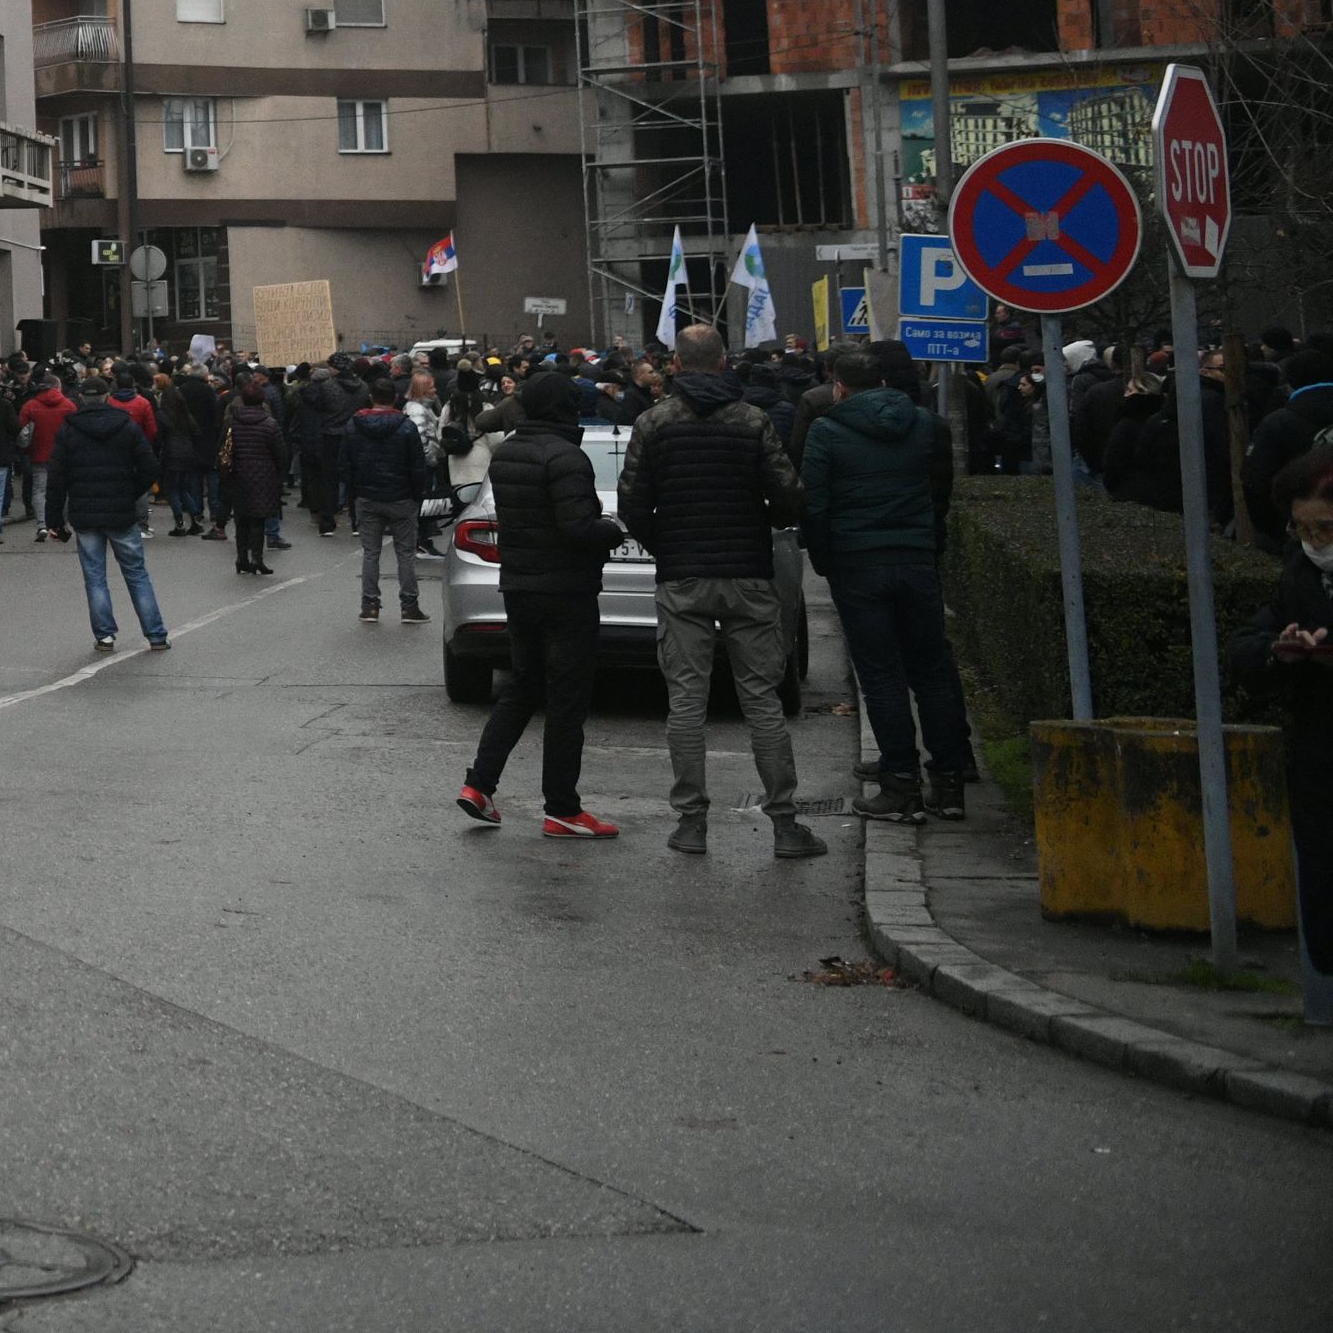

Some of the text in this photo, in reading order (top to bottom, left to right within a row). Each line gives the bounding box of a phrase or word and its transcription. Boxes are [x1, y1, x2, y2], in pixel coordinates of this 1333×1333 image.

[1170, 139, 1219, 204] STOP
[920, 247, 967, 306] P
[905, 326, 982, 340] Само за возила
[927, 343, 960, 356] ПТТ-а
